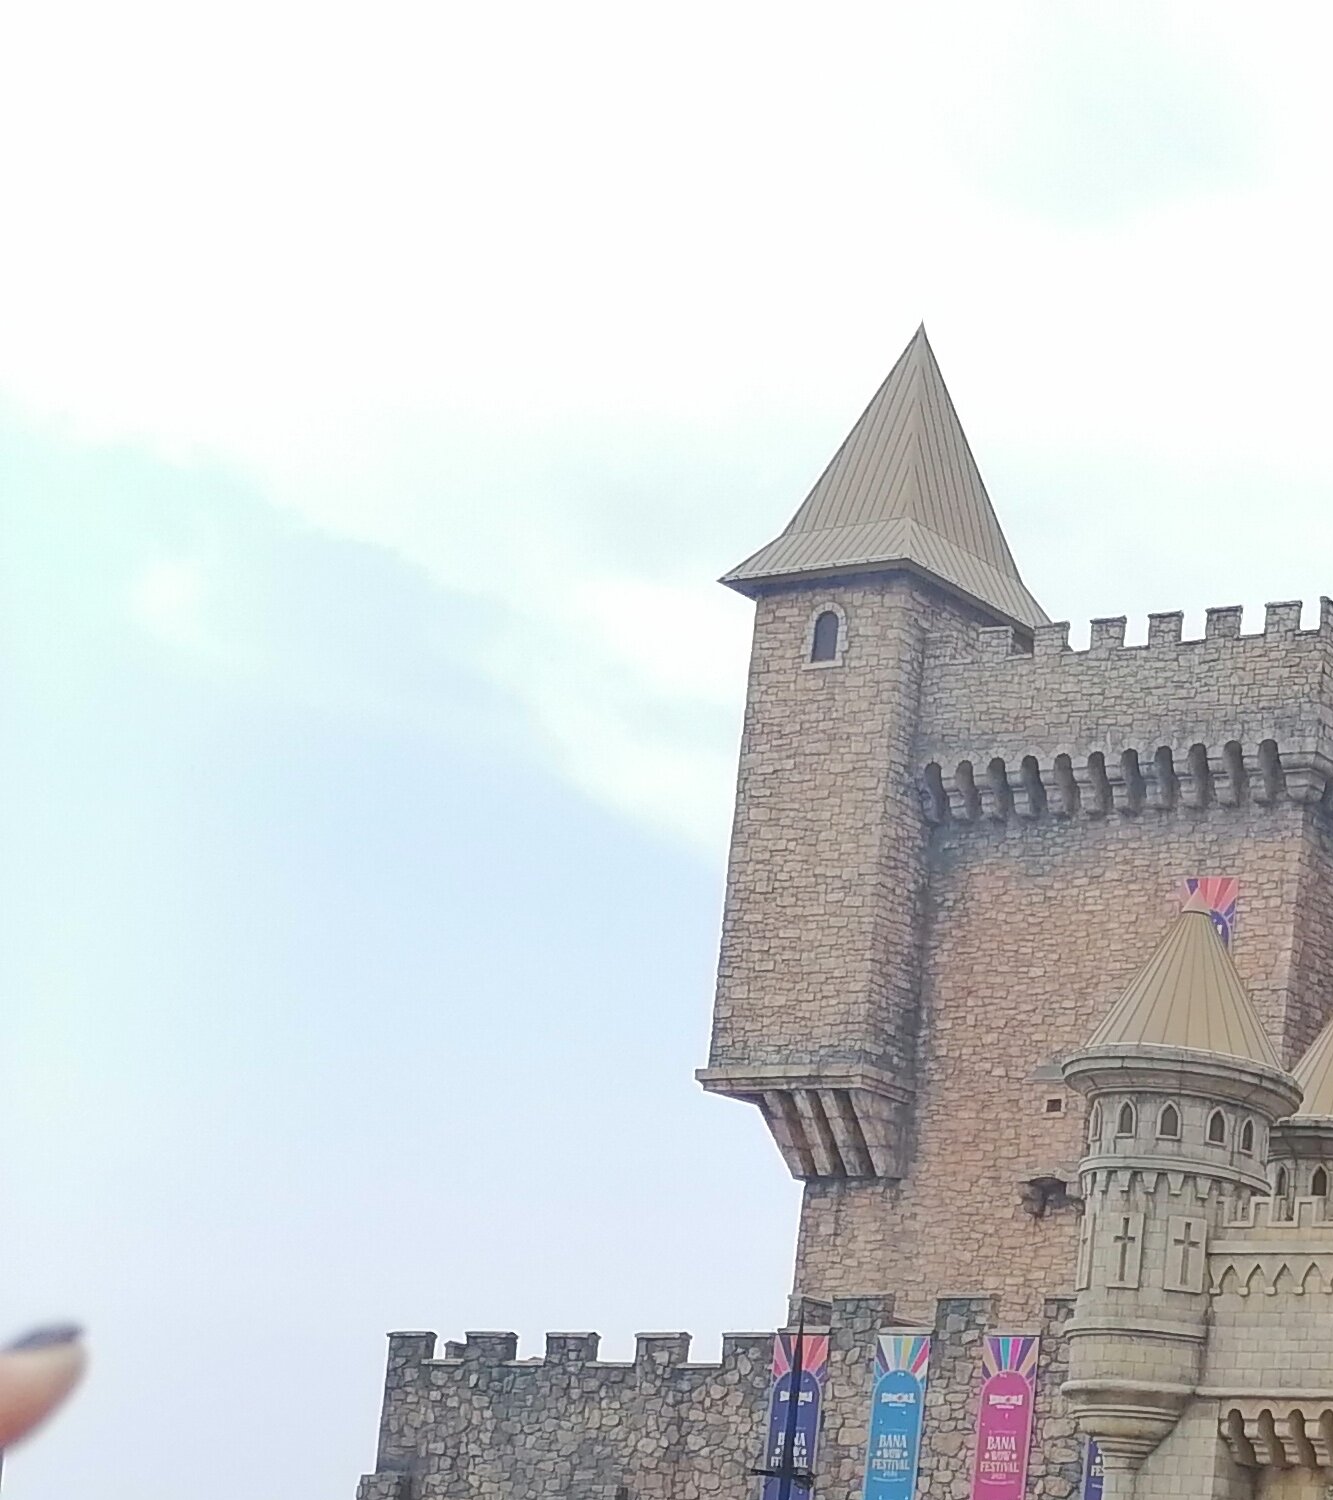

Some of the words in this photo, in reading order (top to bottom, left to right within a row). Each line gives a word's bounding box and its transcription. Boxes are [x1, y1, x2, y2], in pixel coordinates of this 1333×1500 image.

[778, 1432, 805, 1446] BNA
[879, 1434, 906, 1448] BANA
[987, 1436, 1016, 1450] BANA
[991, 1450, 1011, 1461] WOW
[872, 1458, 911, 1470] FESTIVAL
[980, 1461, 1019, 1473] FESTIVAL
